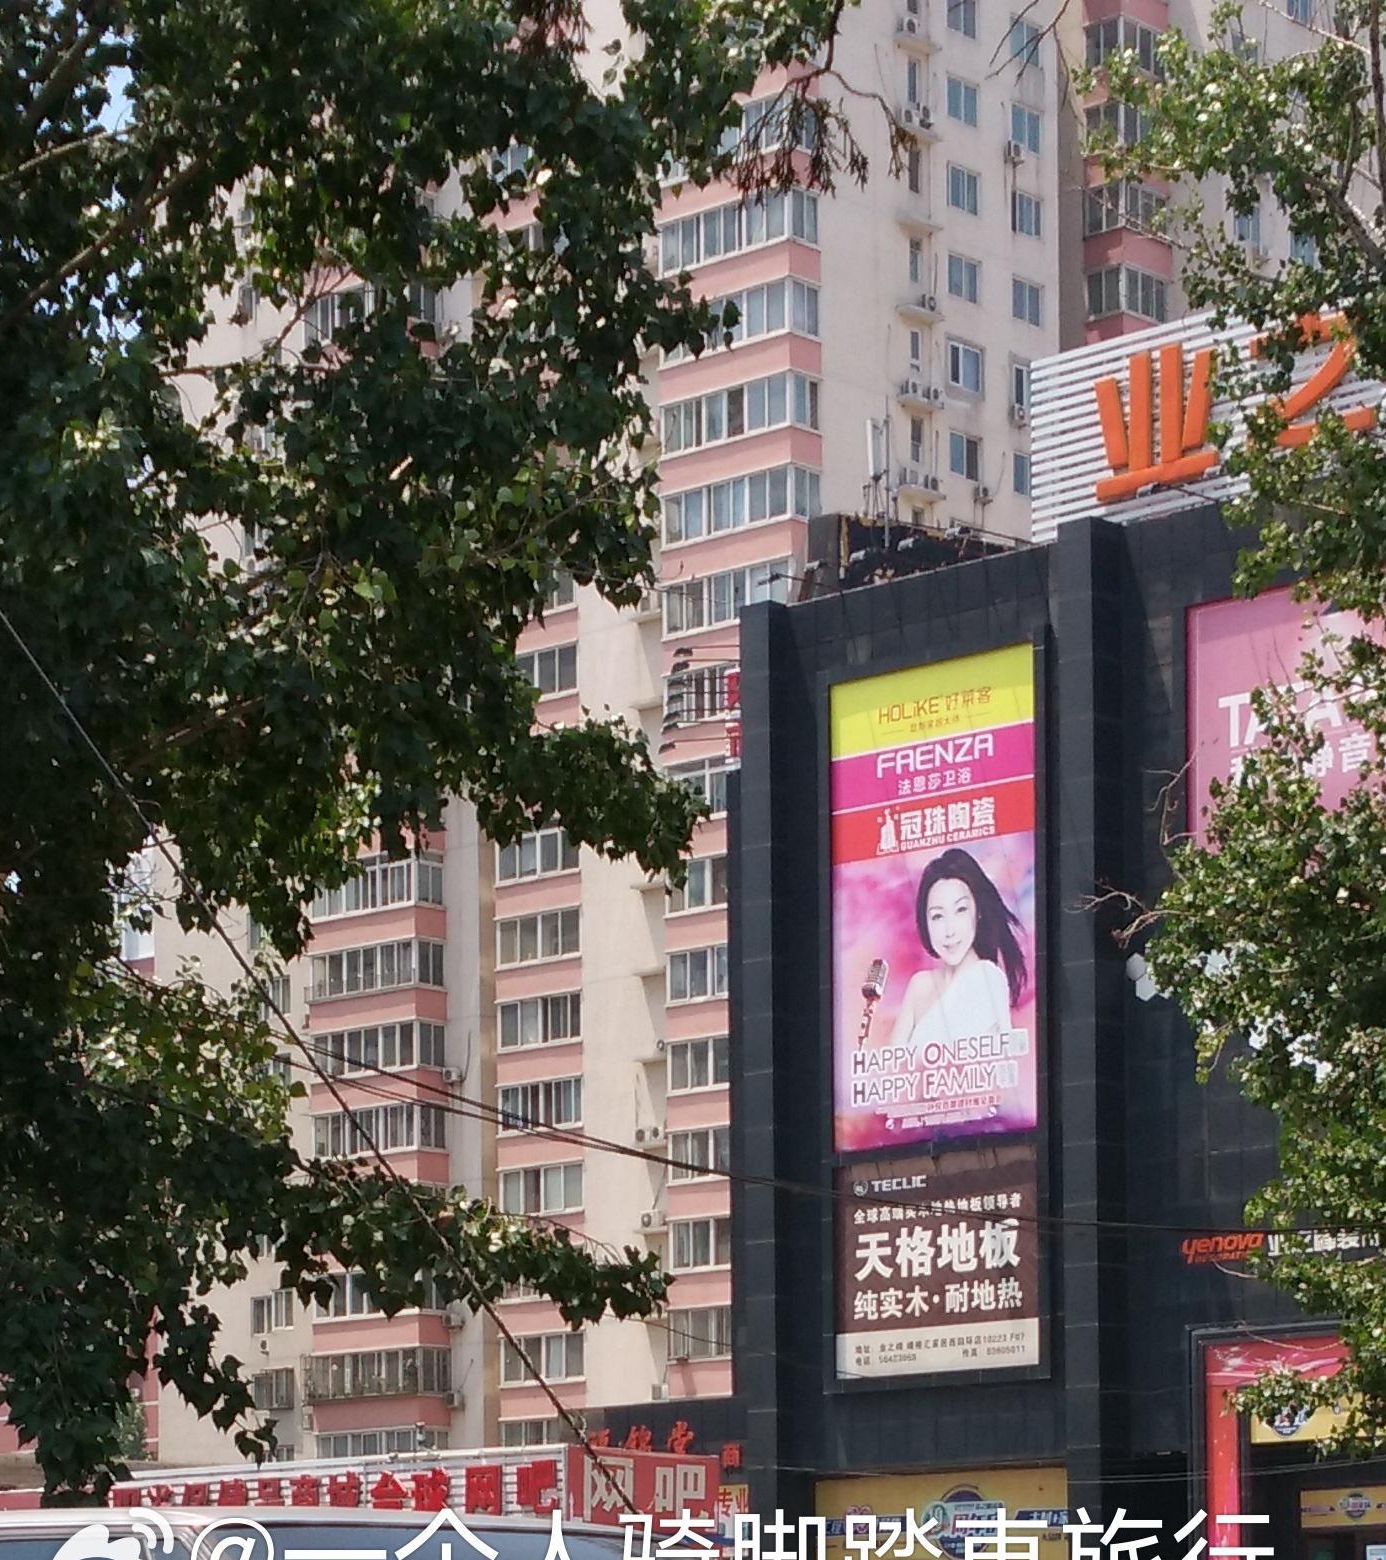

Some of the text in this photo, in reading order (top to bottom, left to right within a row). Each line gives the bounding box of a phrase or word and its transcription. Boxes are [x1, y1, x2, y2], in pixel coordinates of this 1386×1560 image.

[876, 733, 994, 778] FAENZA
[897, 767, 973, 796] 法恩莎卫浴
[900, 796, 995, 841] 冠珠陶瓷
[900, 825, 996, 851] GUANZHU CERAMICS
[853, 1033, 1010, 1076] HAPPY ONESELF
[853, 1075, 919, 1105] HAPPY
[925, 1063, 996, 1097] FAMILY
[871, 1174, 927, 1193] TECLIC
[854, 1218, 1021, 1281] 天格地板
[583, 1455, 707, 1522] 网吧
